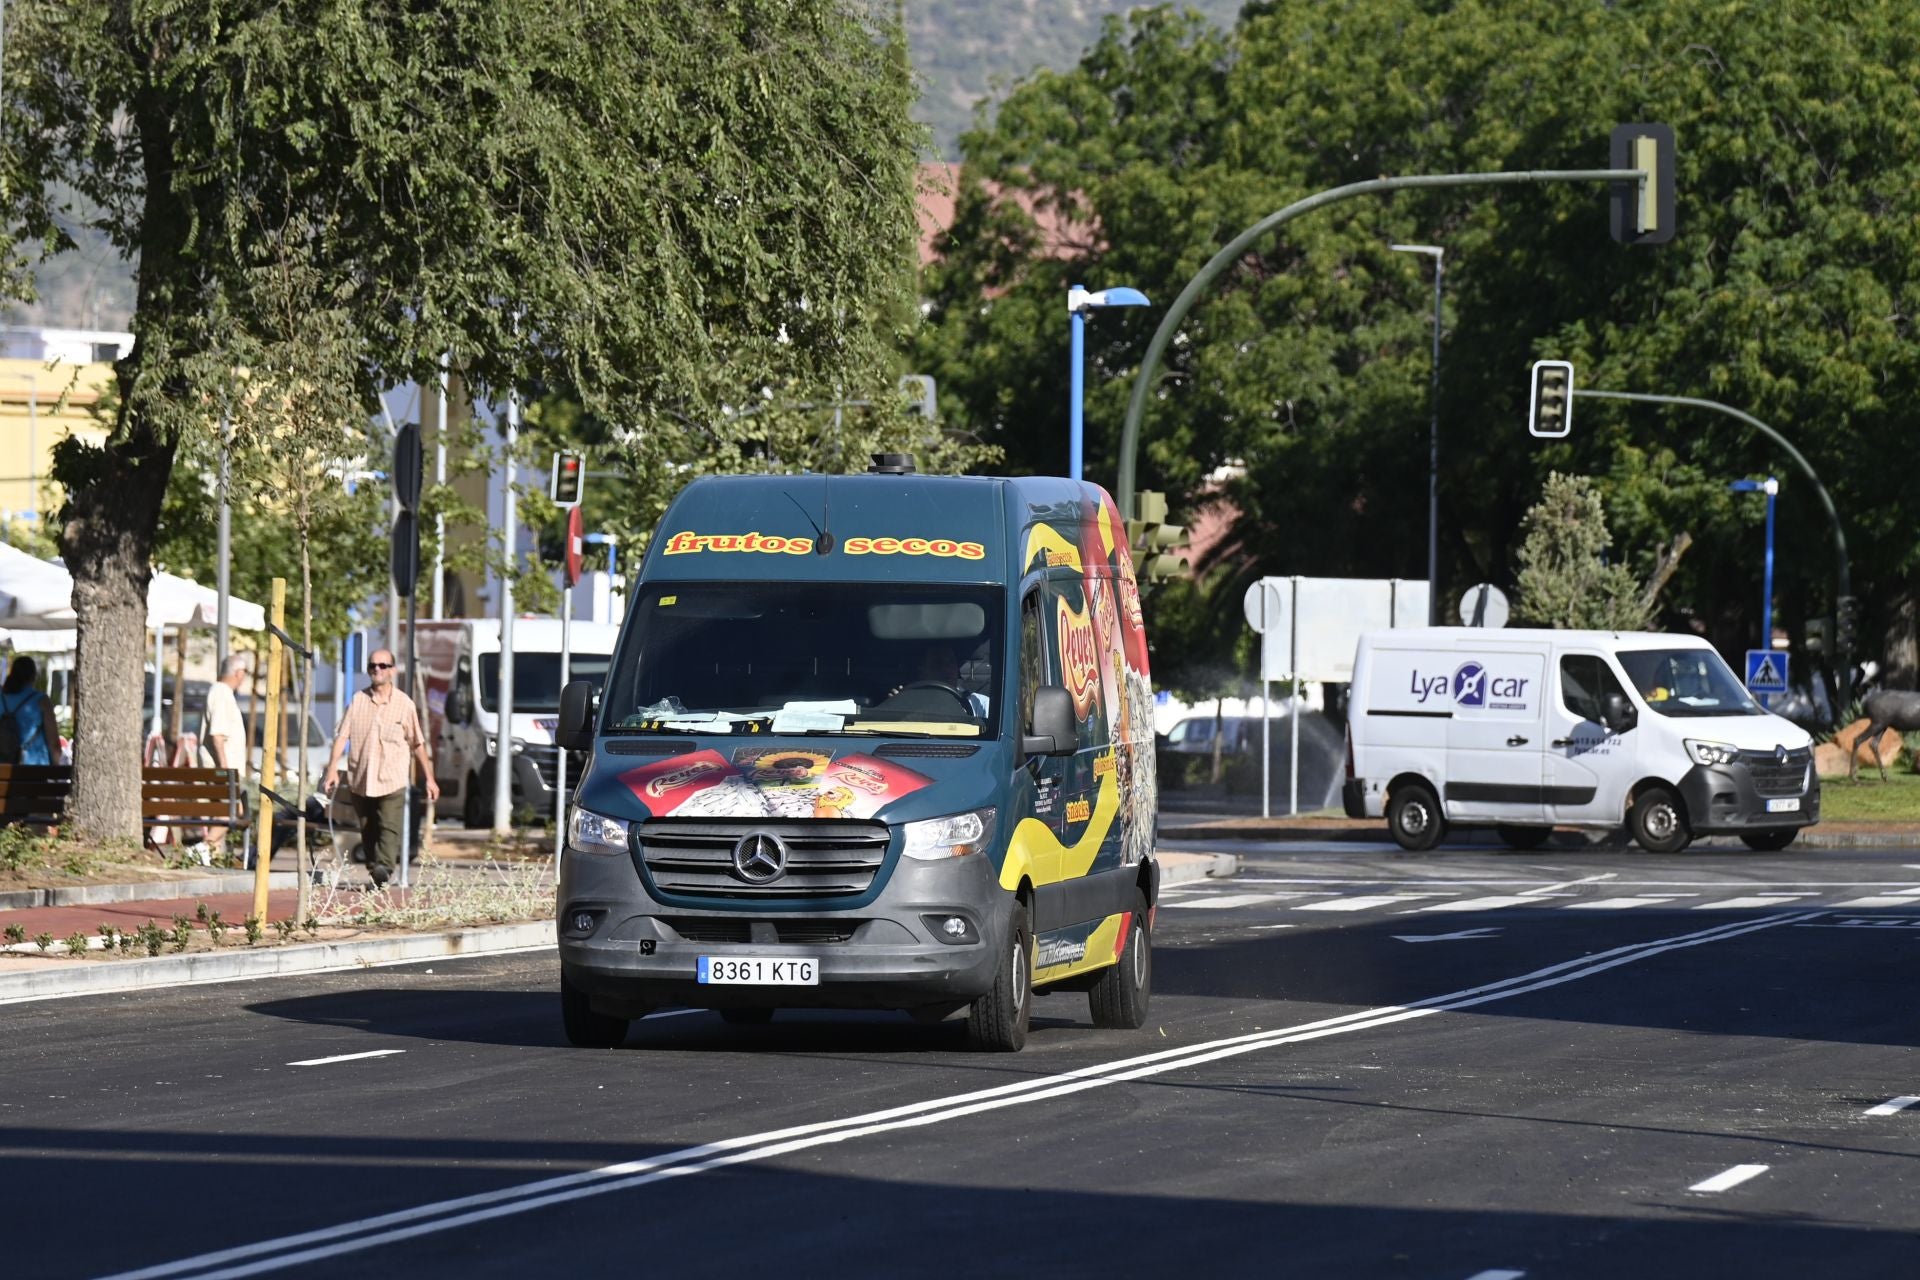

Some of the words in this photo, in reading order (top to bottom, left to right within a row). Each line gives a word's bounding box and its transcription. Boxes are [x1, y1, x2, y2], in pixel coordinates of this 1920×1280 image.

[664, 532, 813, 554] frutos
[844, 538, 984, 559] secos
[1061, 609, 1097, 690] Reyes
[1411, 669, 1448, 703] Lya
[1491, 678, 1529, 698] car
[651, 764, 711, 794] Reyes
[1067, 797, 1089, 822] snacks
[713, 962, 762, 980] 8361
[772, 962, 812, 981] KTG
